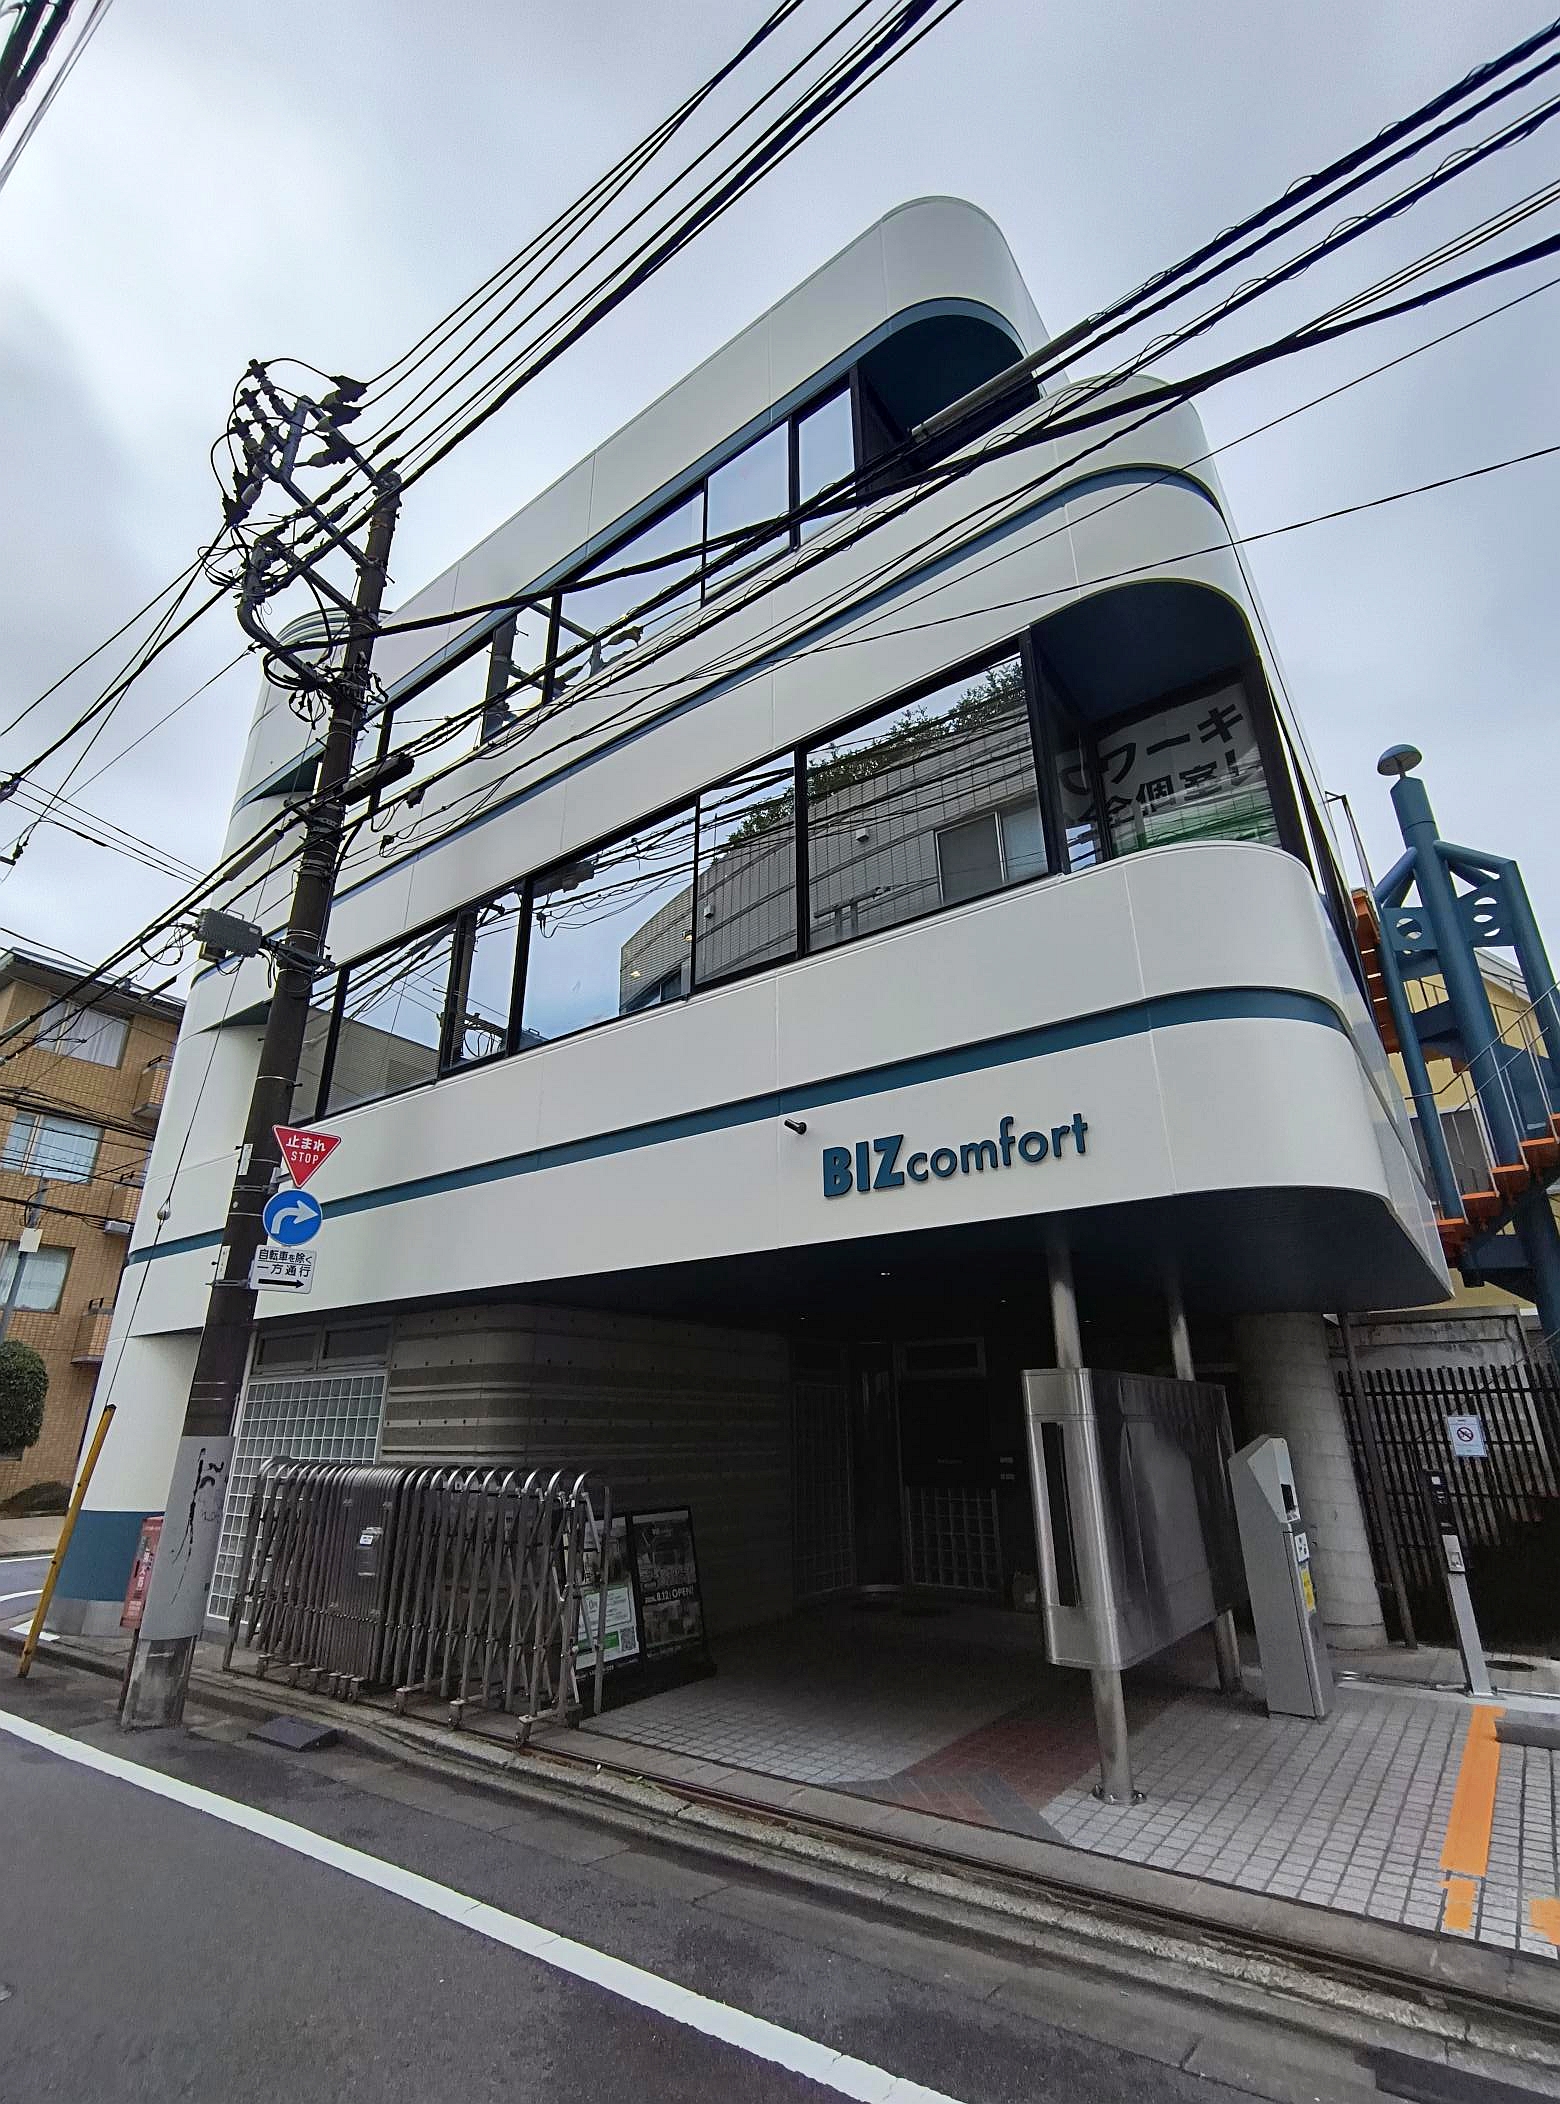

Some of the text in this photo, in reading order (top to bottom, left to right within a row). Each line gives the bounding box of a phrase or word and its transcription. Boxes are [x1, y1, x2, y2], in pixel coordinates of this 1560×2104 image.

[285, 1134, 327, 1152] 止まれ
[290, 1150, 320, 1165] STOP
[823, 1113, 1089, 1198] BIZcomfort
[258, 1248, 313, 1264] 自転車を除く
[256, 1263, 312, 1278] 一方通行
